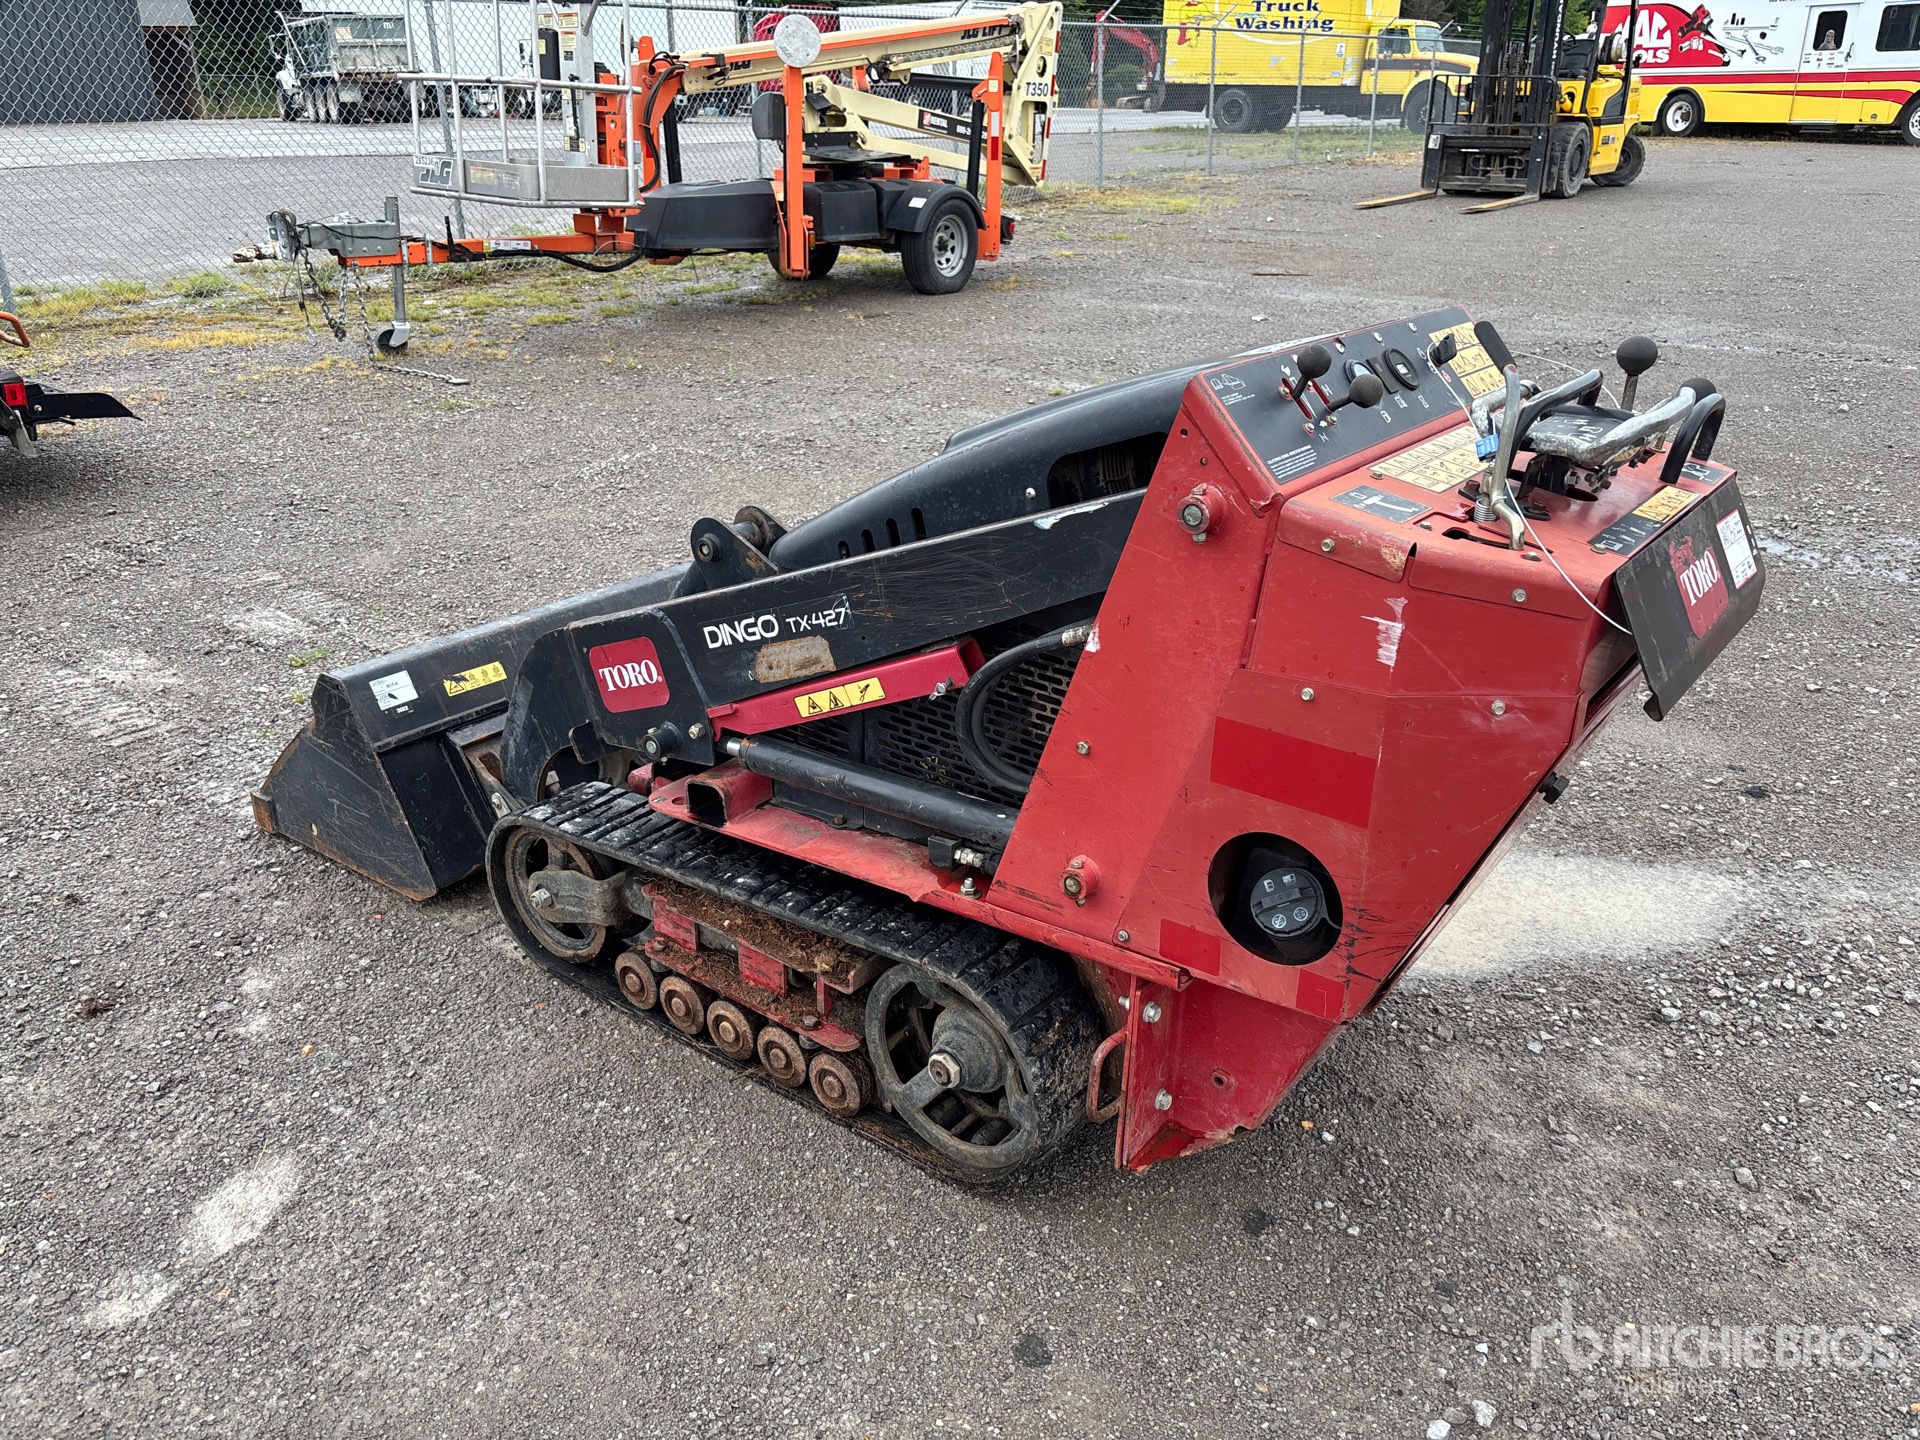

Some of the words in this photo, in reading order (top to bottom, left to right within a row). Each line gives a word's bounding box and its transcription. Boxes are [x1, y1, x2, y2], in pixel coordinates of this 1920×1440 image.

[1252, 0, 1320, 12] Truck
[1235, 16, 1335, 32] Washing
[961, 27, 979, 40] JLG
[1025, 81, 1049, 97] T350
[1679, 550, 1719, 607] TORO
[703, 614, 779, 649] DINGO
[598, 659, 660, 692] TORO
